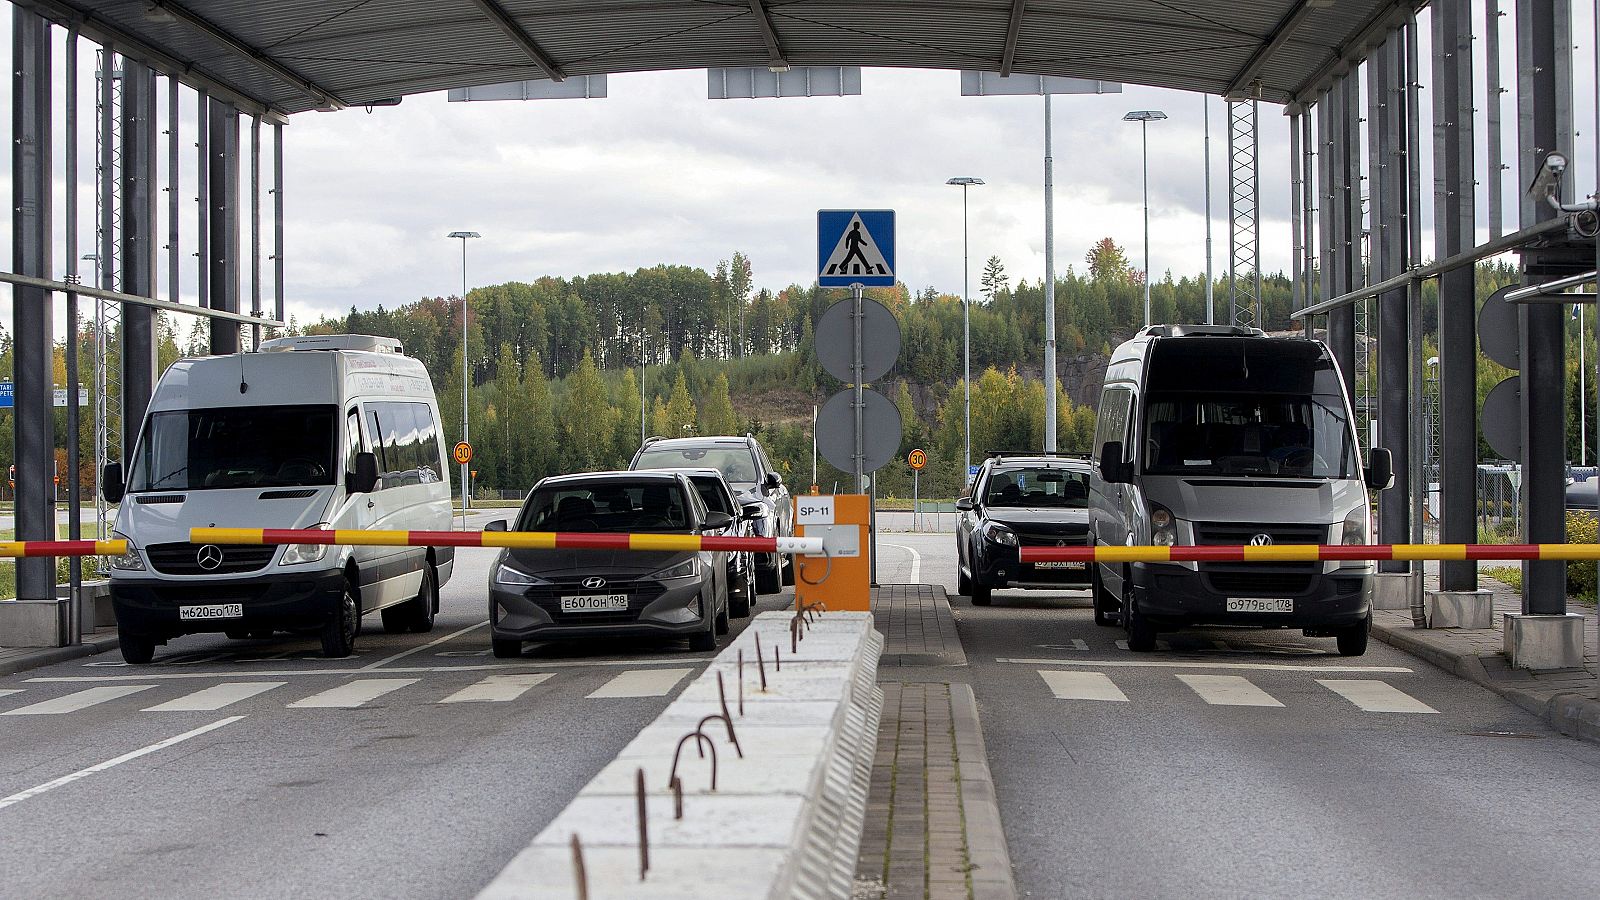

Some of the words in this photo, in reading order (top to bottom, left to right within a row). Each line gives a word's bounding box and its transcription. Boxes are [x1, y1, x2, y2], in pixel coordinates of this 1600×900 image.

[458, 448, 468, 458] 30
[912, 454, 924, 464] 30
[800, 507, 829, 516] SP-11
[1276, 600, 1290, 608] 178
[224, 605, 239, 614] 178
